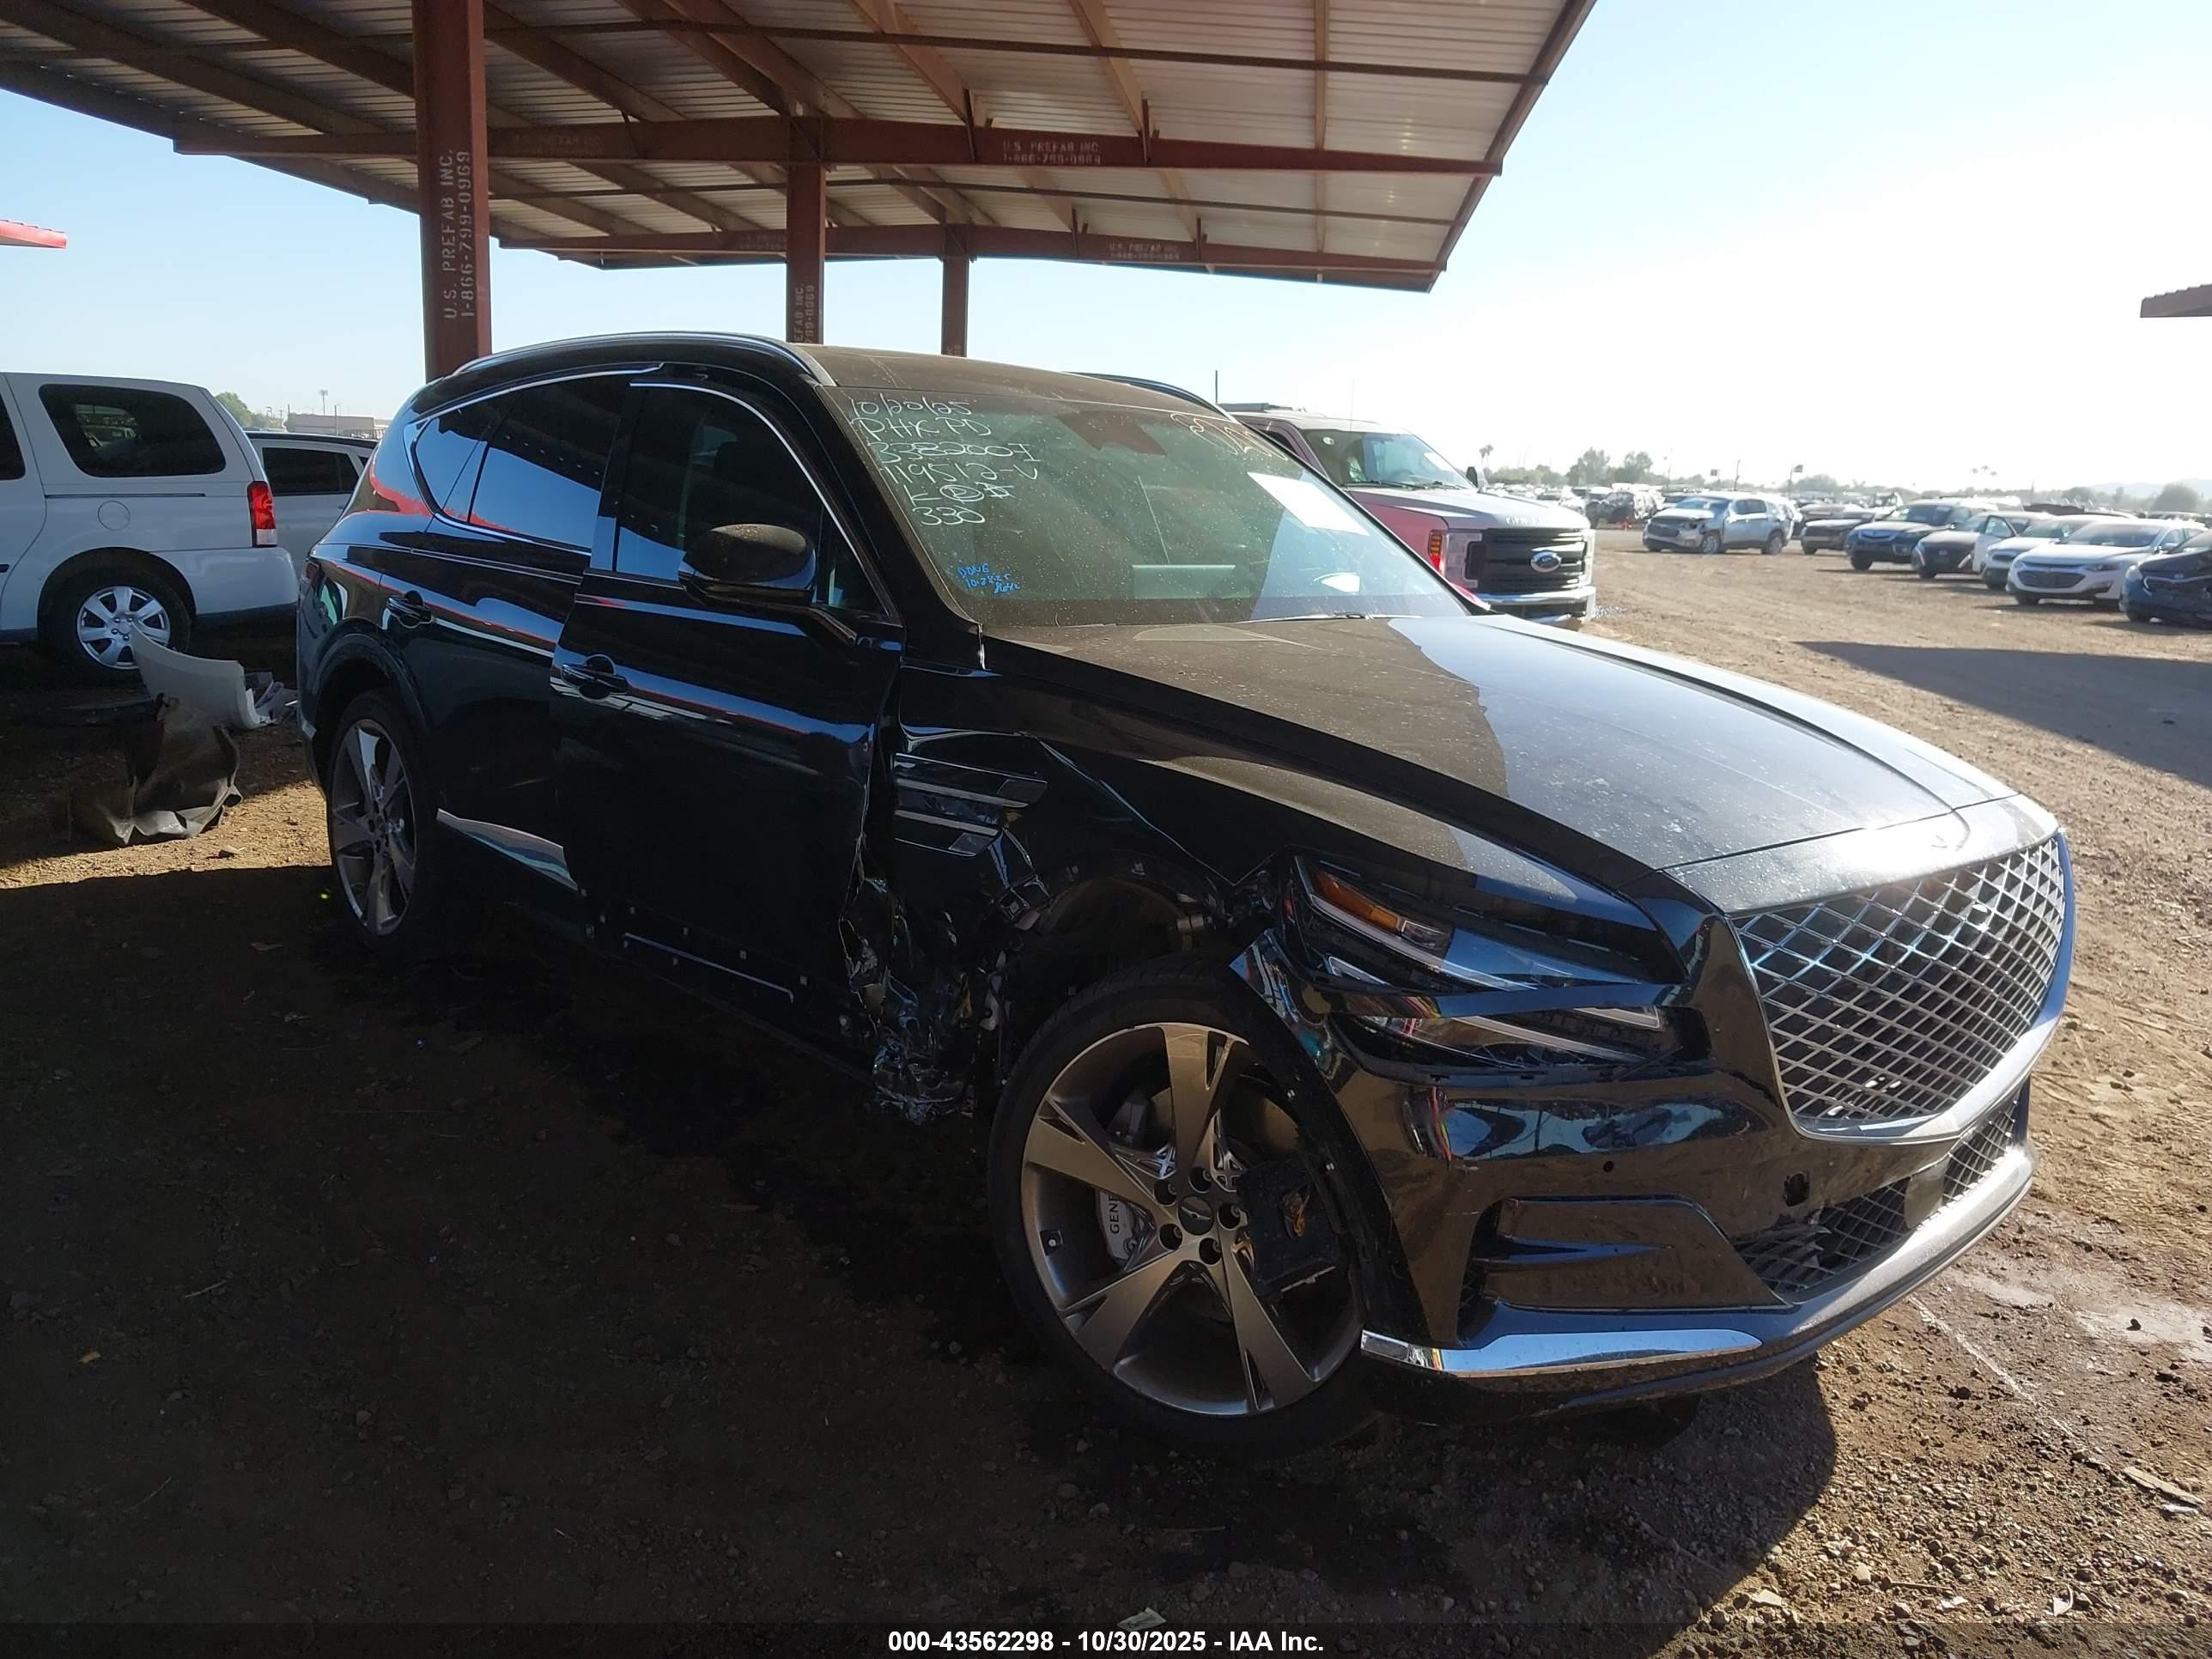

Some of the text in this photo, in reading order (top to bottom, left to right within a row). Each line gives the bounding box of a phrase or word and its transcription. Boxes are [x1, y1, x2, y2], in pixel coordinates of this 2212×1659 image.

[439, 149, 458, 319] U.S. PREFAB INC.
[456, 151, 475, 318] 1-866-799-0969
[851, 392, 972, 416] 10/20/25
